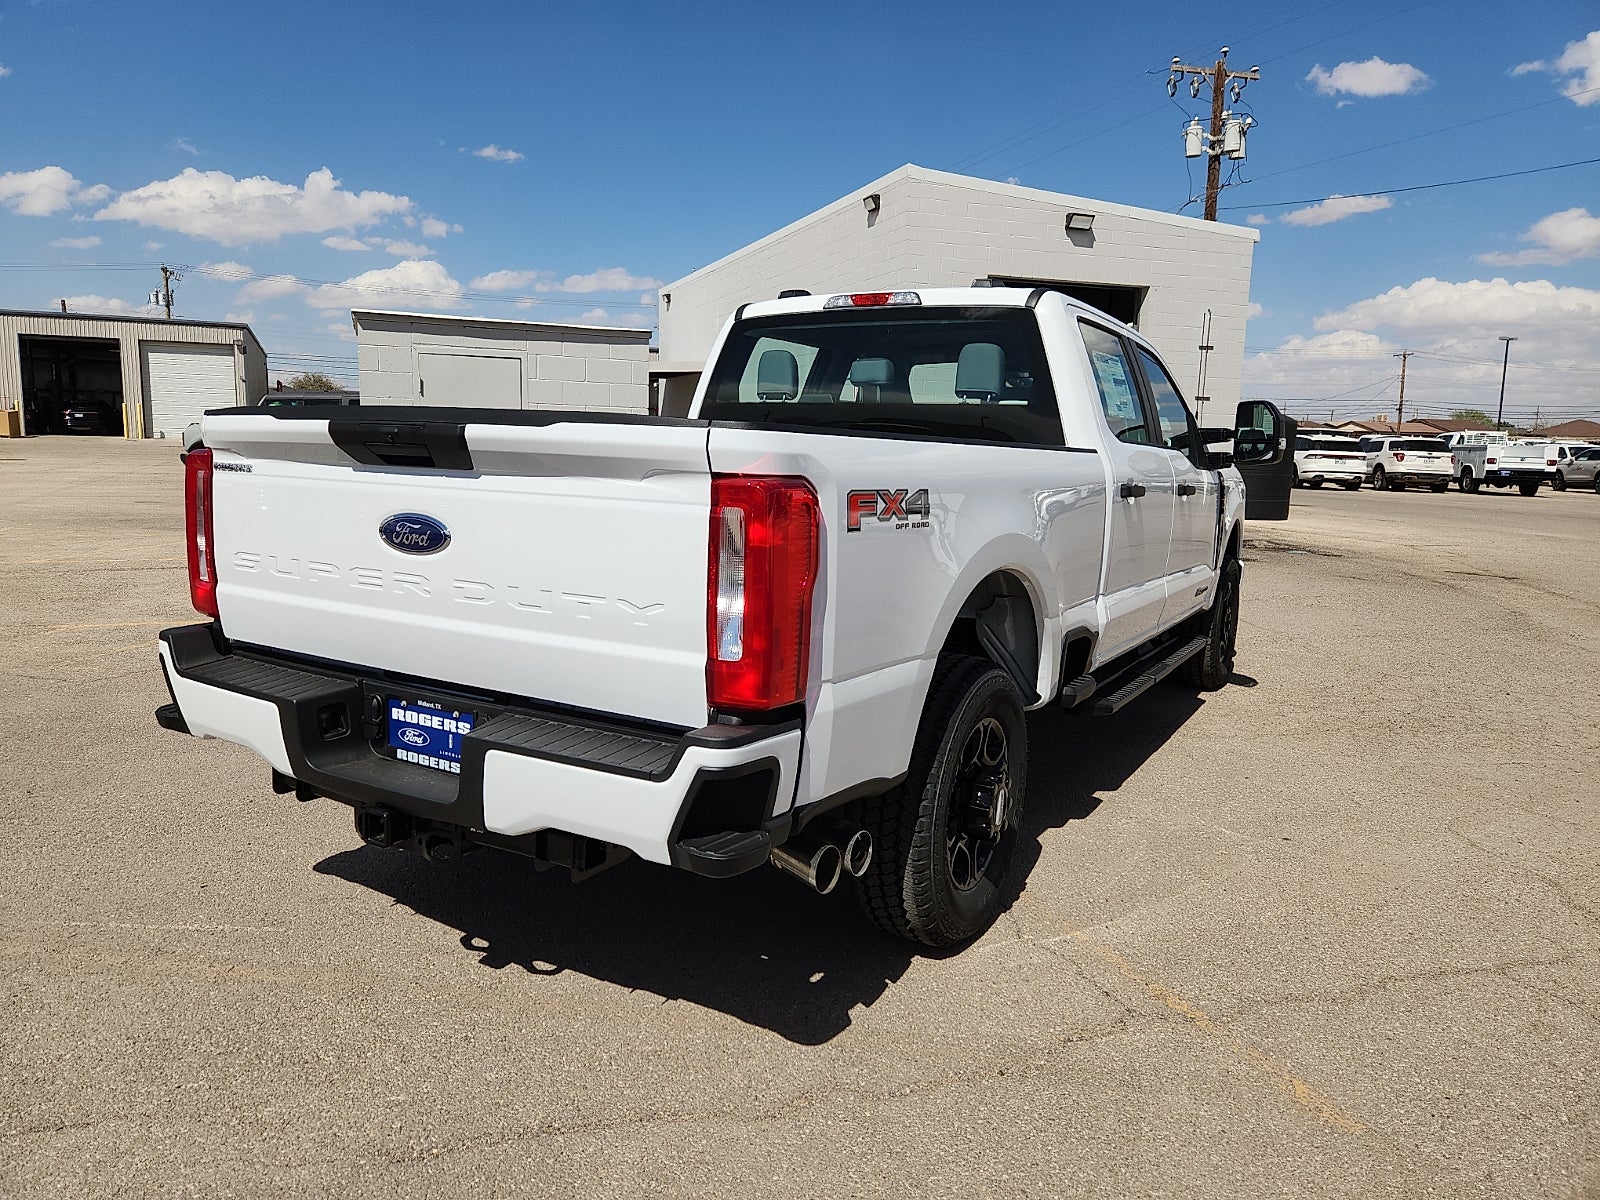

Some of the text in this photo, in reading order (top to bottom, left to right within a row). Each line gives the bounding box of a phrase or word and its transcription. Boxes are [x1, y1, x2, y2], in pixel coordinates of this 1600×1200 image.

[846, 488, 930, 533] FX4
[392, 521, 431, 547] Ford
[233, 551, 666, 627] SUPER DUTY
[391, 707, 471, 735] ROGERS
[403, 729, 424, 744] Ford
[396, 748, 461, 774] ROGERS
